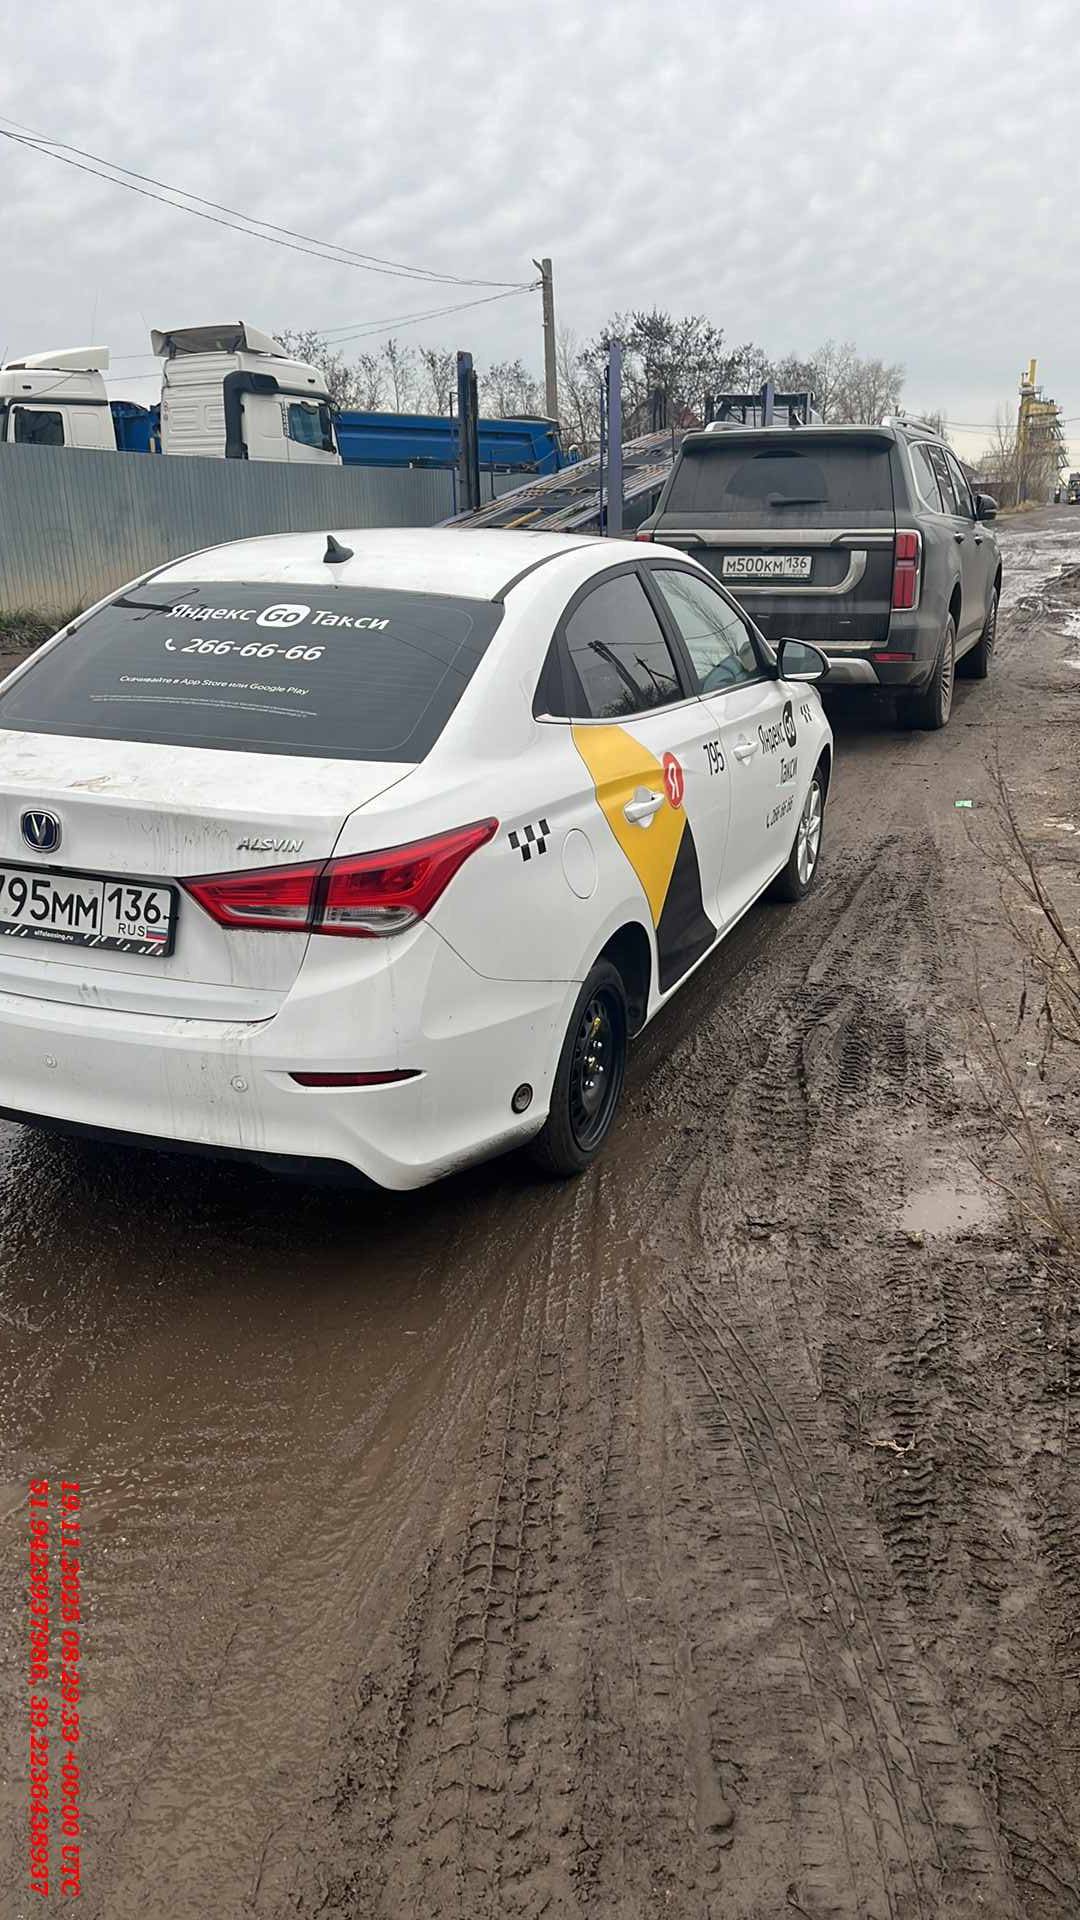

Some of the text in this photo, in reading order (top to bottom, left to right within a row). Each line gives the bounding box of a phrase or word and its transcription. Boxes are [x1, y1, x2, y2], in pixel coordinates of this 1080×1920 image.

[726, 558, 783, 572] М500КМ
[786, 557, 807, 569] 136
[166, 604, 257, 621] Яндекс
[310, 610, 391, 630] Такси
[181, 638, 326, 660] 266-66-66
[180, 678, 200, 687] App
[201, 680, 228, 688] Store
[249, 683, 286, 693] Google
[286, 687, 310, 696] Play
[758, 722, 785, 755] Яндекс
[703, 741, 725, 776] 795
[667, 761, 680, 801] Я
[236, 838, 304, 853] ALSVIN
[108, 887, 161, 924] 136
[118, 922, 145, 937] RUS
